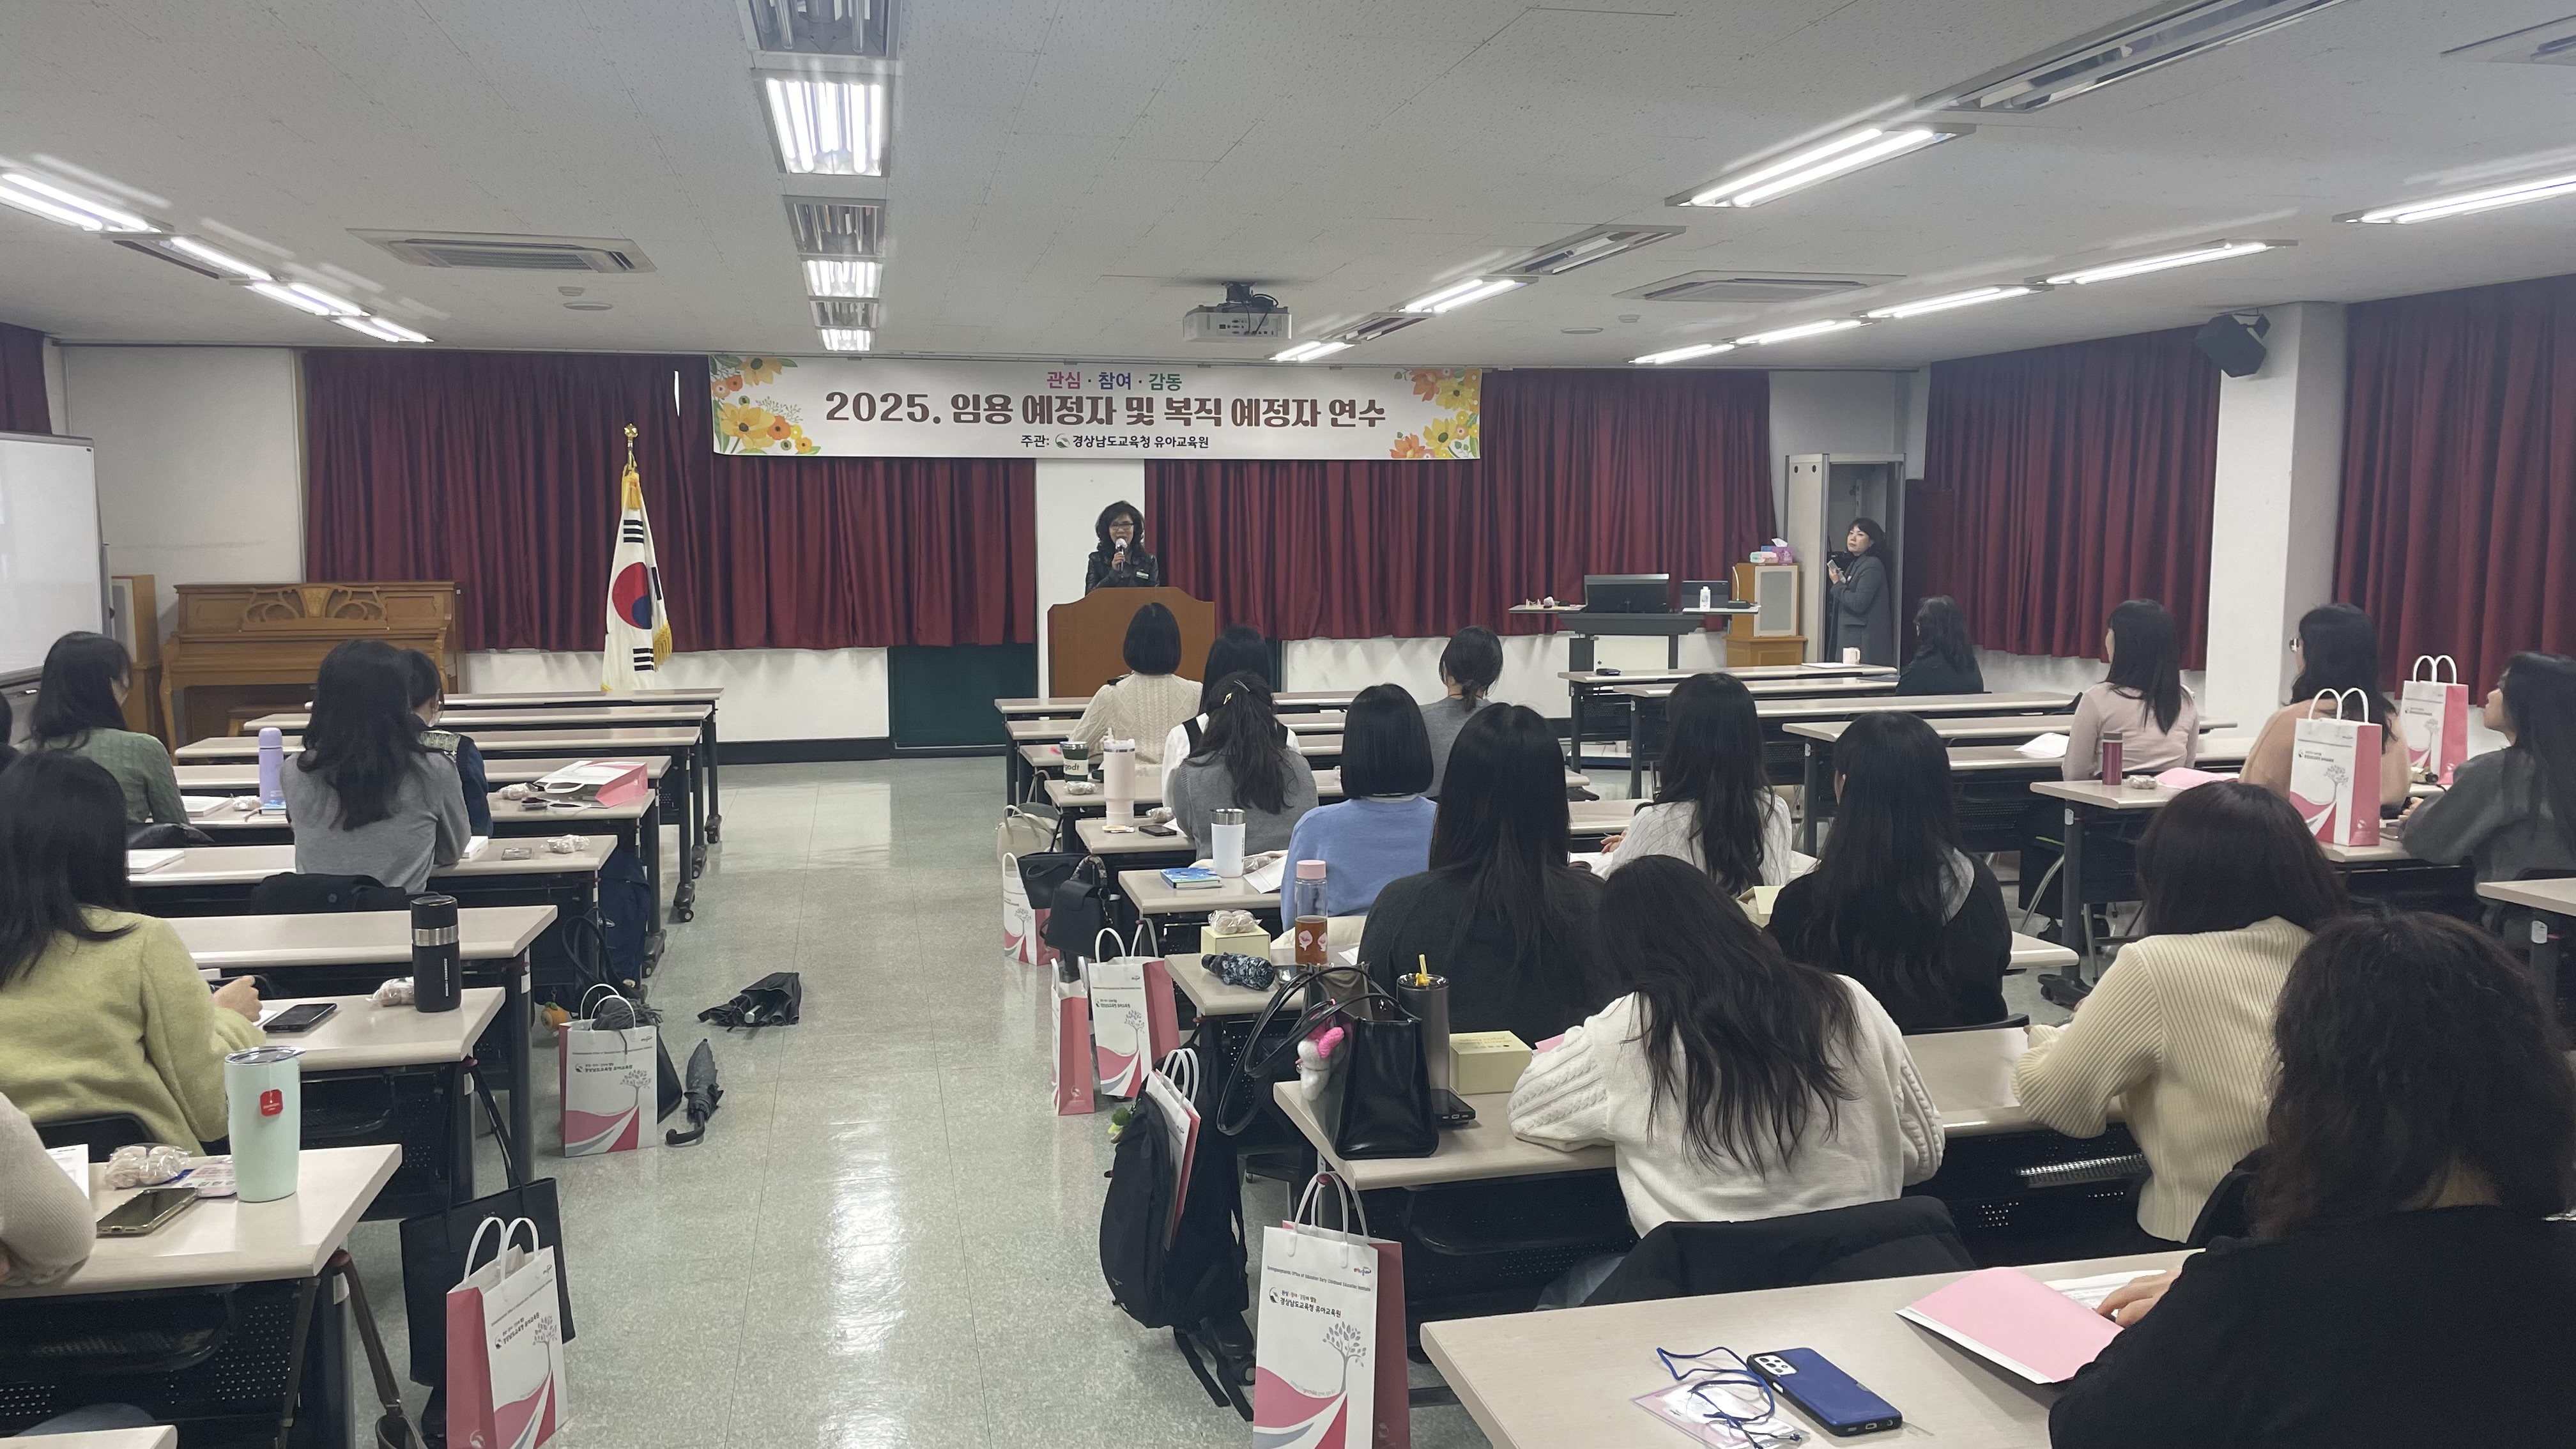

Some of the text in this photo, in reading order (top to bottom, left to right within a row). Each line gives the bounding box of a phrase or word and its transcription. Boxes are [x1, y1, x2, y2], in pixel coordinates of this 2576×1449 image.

[1046, 371, 1183, 391] 관심 참여 감동
[825, 392, 1386, 427] 2025. 임용 예정자 및 복직 예정자 연수
[1021, 435, 1209, 448] 주관: 경상남도교육청 유아교육원
